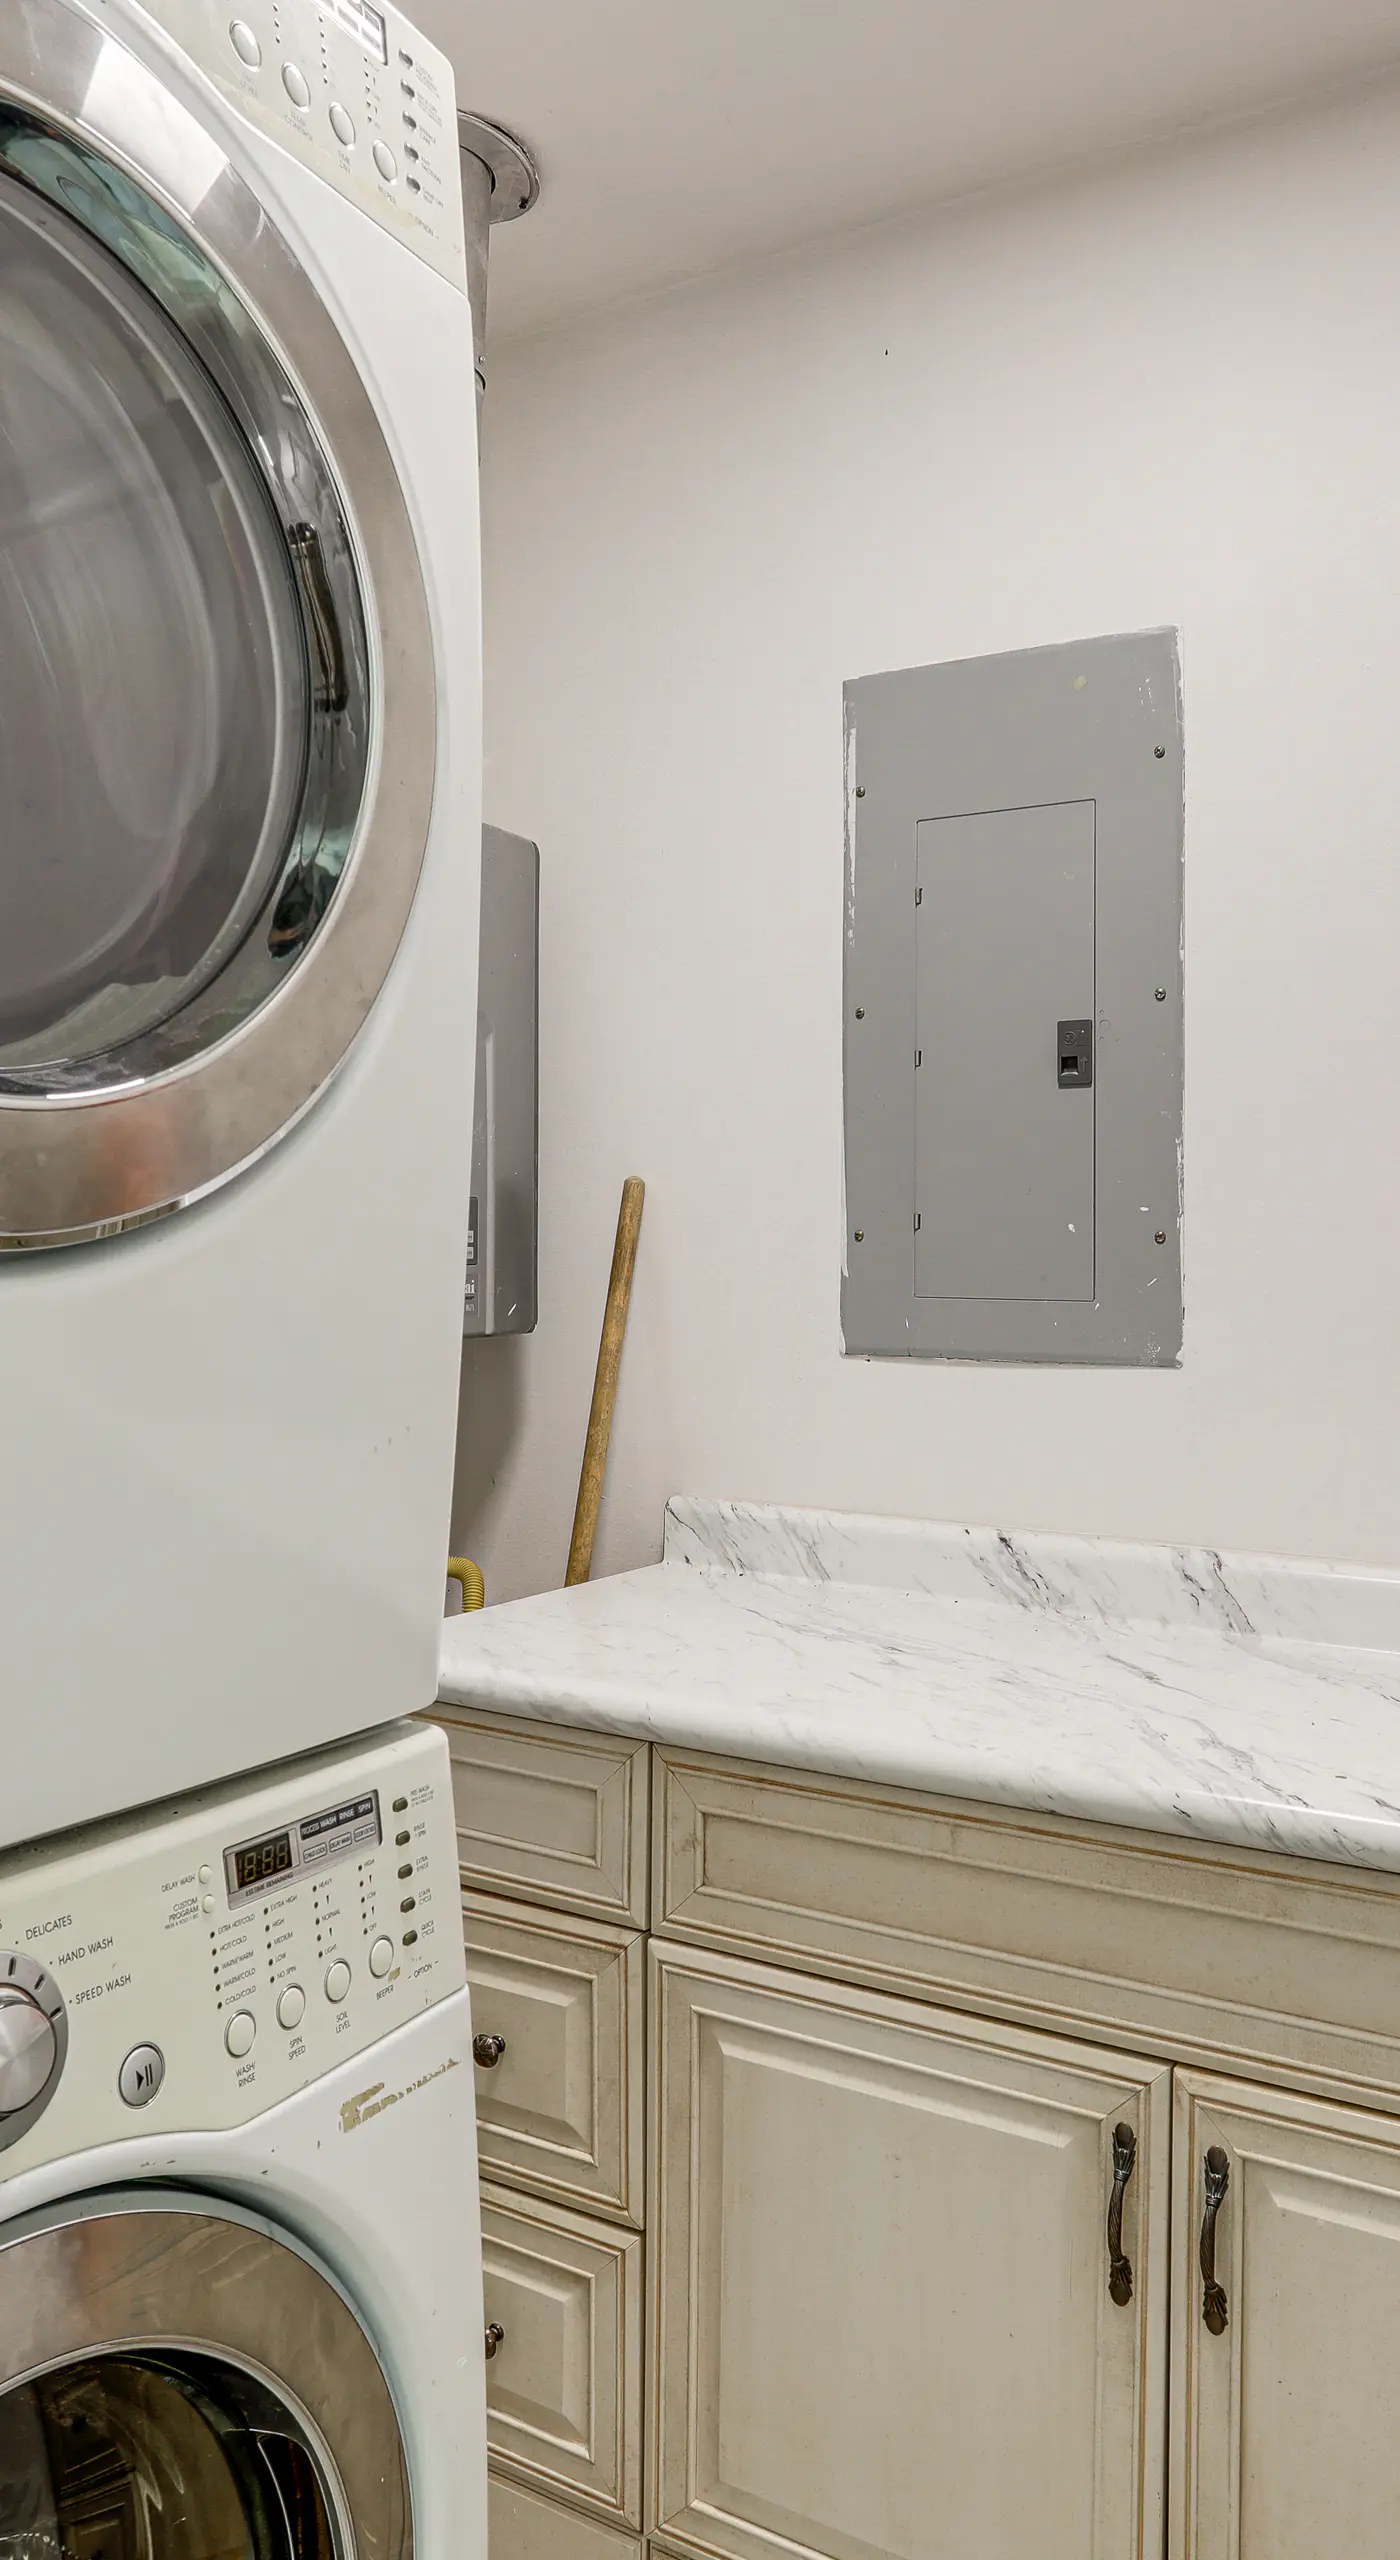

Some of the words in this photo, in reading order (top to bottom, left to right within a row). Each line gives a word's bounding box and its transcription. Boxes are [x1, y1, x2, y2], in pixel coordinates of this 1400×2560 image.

[320, 1816, 336, 1827] WASH
[339, 1809, 354, 1819] RINSE
[358, 1802, 371, 1813] SPIN
[161, 1882, 178, 1892] DELAY
[180, 1875, 195, 1886] WASH
[266, 1872, 293, 1888] REMAINING
[319, 1879, 332, 1888] HEAVY
[173, 1897, 198, 1912] CUSTOM
[270, 1900, 284, 1911] EXTRA
[286, 1895, 297, 1904] HIGH
[169, 1905, 199, 1922] PROGRAM
[232, 1914, 255, 1927] HOT/COLD
[322, 1909, 340, 1922] NORMAL
[26, 1915, 72, 1940] DELICATES
[272, 1918, 284, 1927] HIGH
[220, 1935, 247, 1951] HOT/COLD
[274, 1932, 293, 1944] MEDIUM
[58, 1947, 85, 1966] HAND
[88, 1936, 113, 1954] WASH
[275, 1952, 286, 1962] LOW
[223, 1968, 255, 1987] WARM/COLD
[277, 1971, 285, 1979] NO
[286, 1966, 296, 1974] SPIN
[75, 1986, 103, 2005] SPEED
[105, 1974, 131, 1992] WASH
[225, 1985, 256, 2005] COLD/COLD
[376, 1985, 394, 2000] BEEPER
[336, 2011, 348, 2022] SOIL
[336, 2021, 350, 2034] LEVEL
[290, 2036, 302, 2048] SPIN
[289, 2045, 306, 2060] SPEED
[235, 2061, 256, 2078] WASH/
[238, 2073, 256, 2088] RINSE
